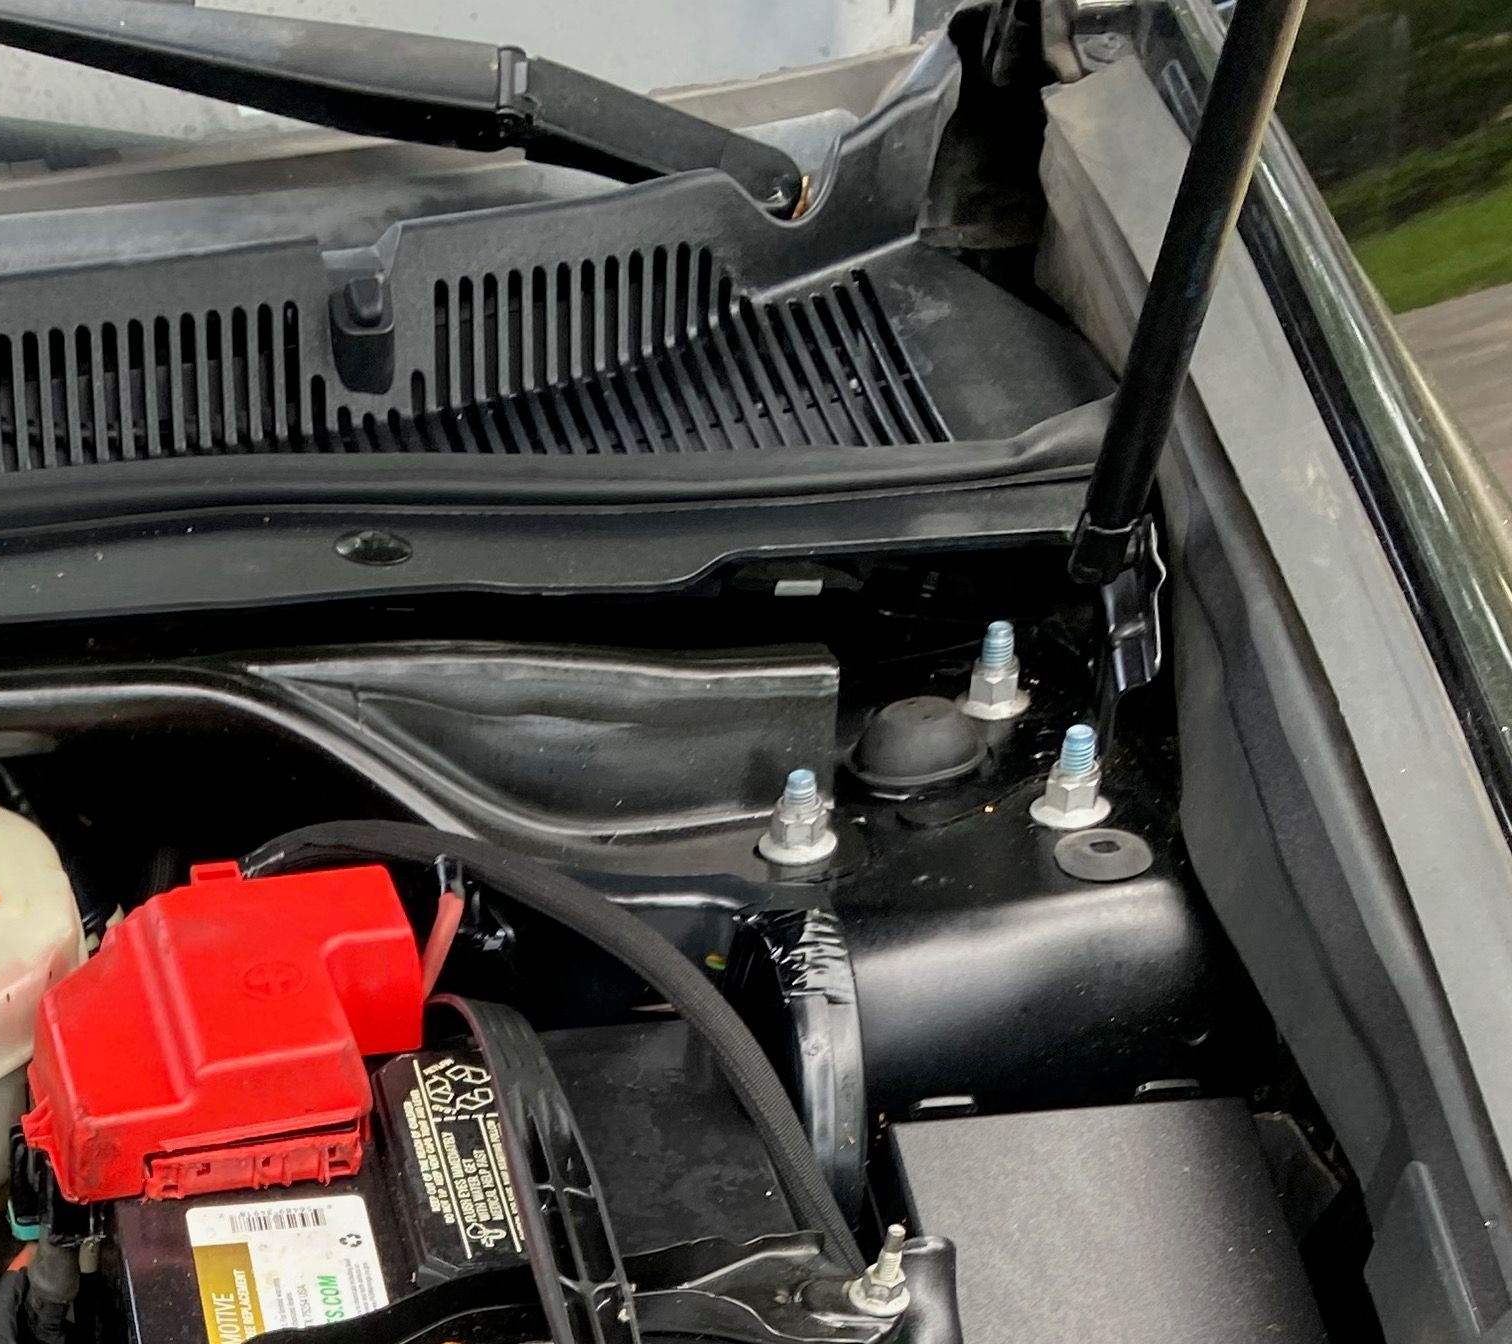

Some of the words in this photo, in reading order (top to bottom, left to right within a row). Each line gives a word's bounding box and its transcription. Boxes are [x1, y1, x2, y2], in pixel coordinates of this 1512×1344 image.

[441, 1132, 464, 1178] IMMEDIATELY
[462, 1158, 477, 1173] GET
[473, 1149, 488, 1167] FAST
[454, 1179, 469, 1198] EYES
[479, 1169, 494, 1188] HELP
[460, 1199, 477, 1222] FLUSH
[475, 1202, 490, 1222] WITH
[486, 1189, 504, 1220] MEDICAL
[233, 1269, 254, 1324] REPLACEMENT
[317, 1275, 344, 1323] S.COM
